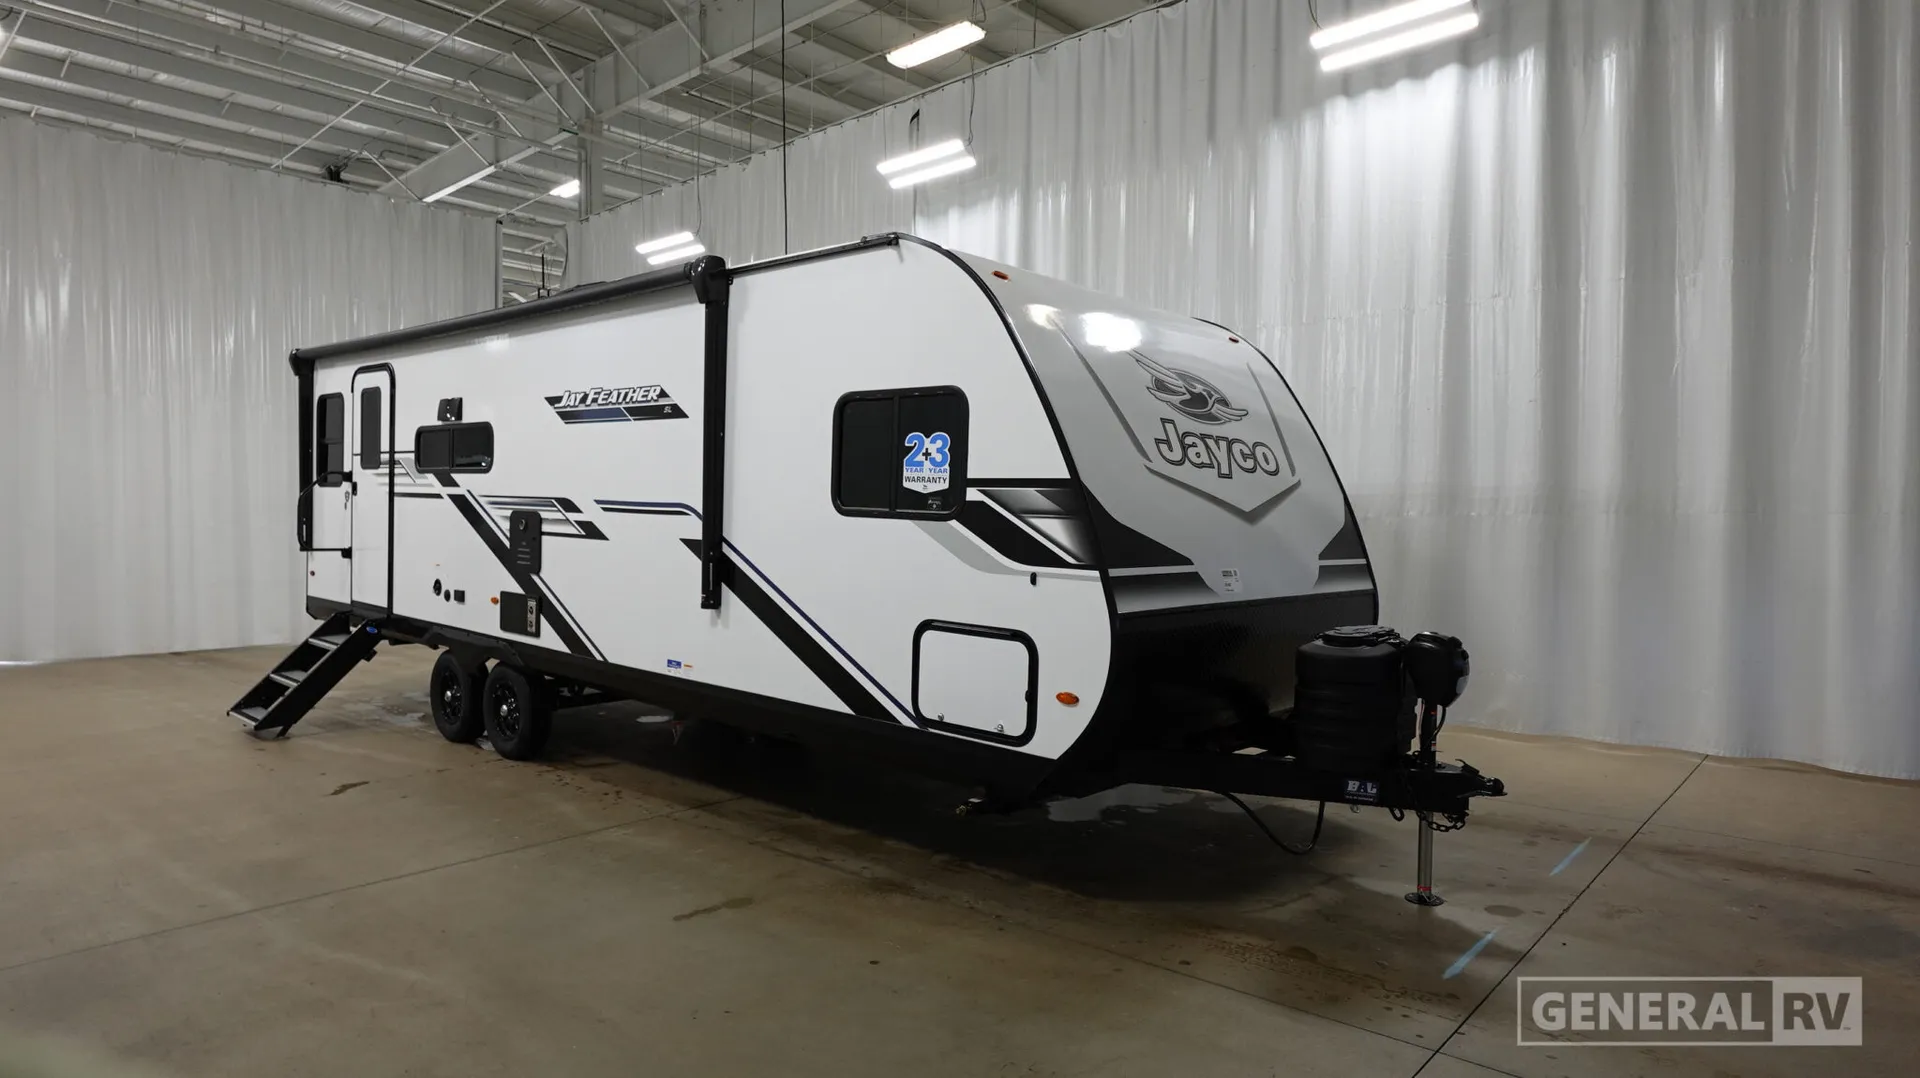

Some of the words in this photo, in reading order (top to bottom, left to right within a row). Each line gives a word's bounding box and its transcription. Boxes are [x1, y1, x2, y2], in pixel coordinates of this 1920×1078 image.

[554, 390, 585, 408] JAY
[585, 385, 661, 405] FEATHER
[1154, 418, 1279, 479] Jayco
[904, 475, 948, 484] WARRANTY
